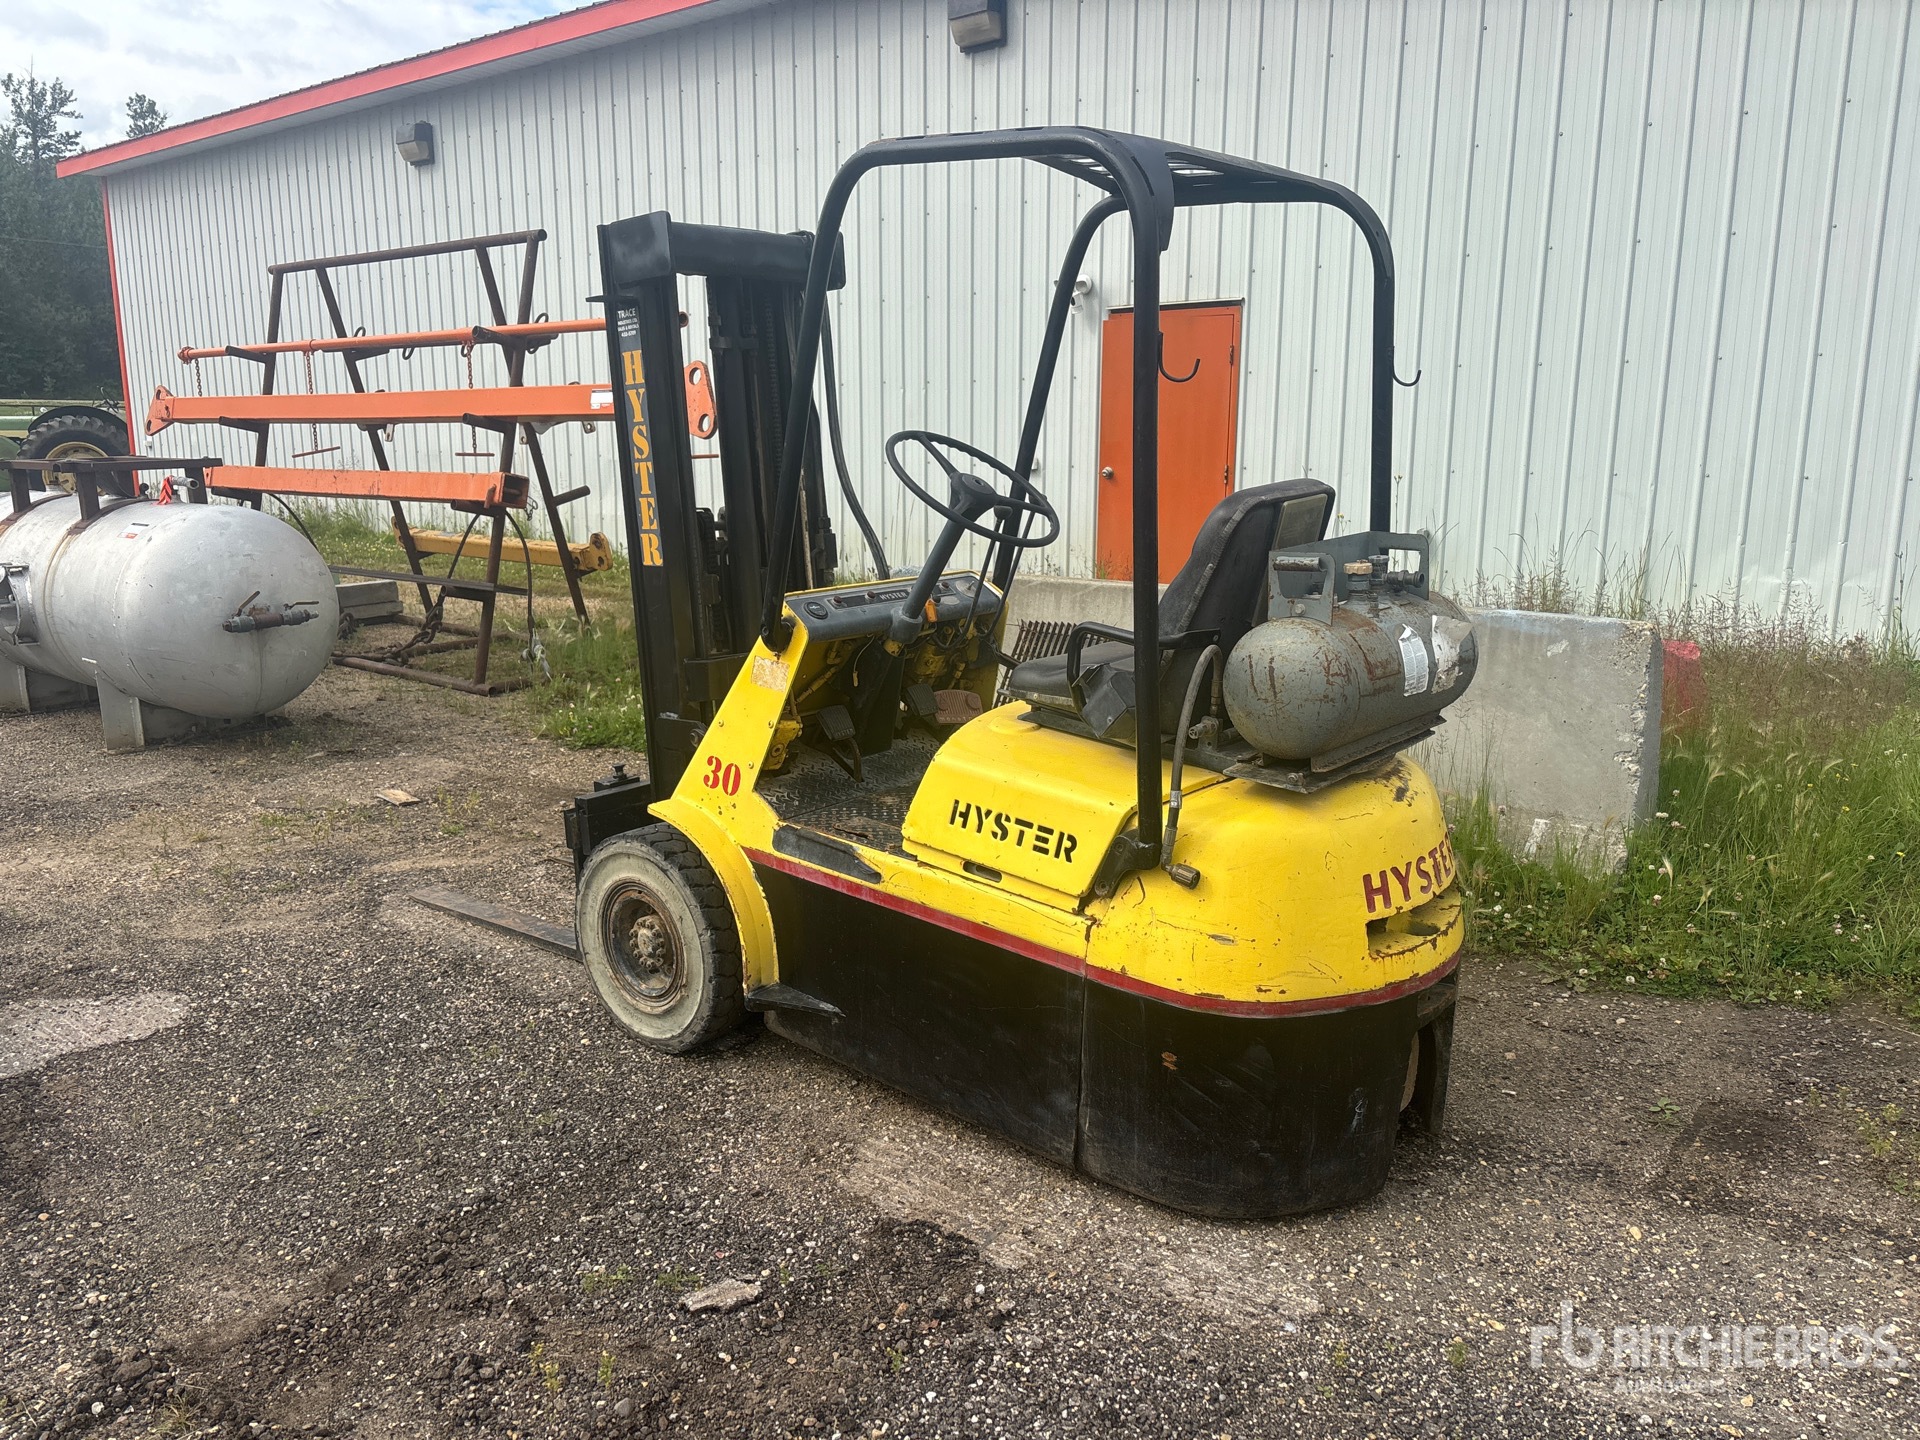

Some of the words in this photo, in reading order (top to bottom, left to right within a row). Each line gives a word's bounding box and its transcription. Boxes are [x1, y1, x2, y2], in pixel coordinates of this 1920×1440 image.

[617, 308, 636, 318] TRACE
[621, 350, 663, 566] HYSTER
[879, 592, 907, 600] HYSTER
[703, 755, 741, 796] 30
[949, 799, 1078, 864] HYSTER
